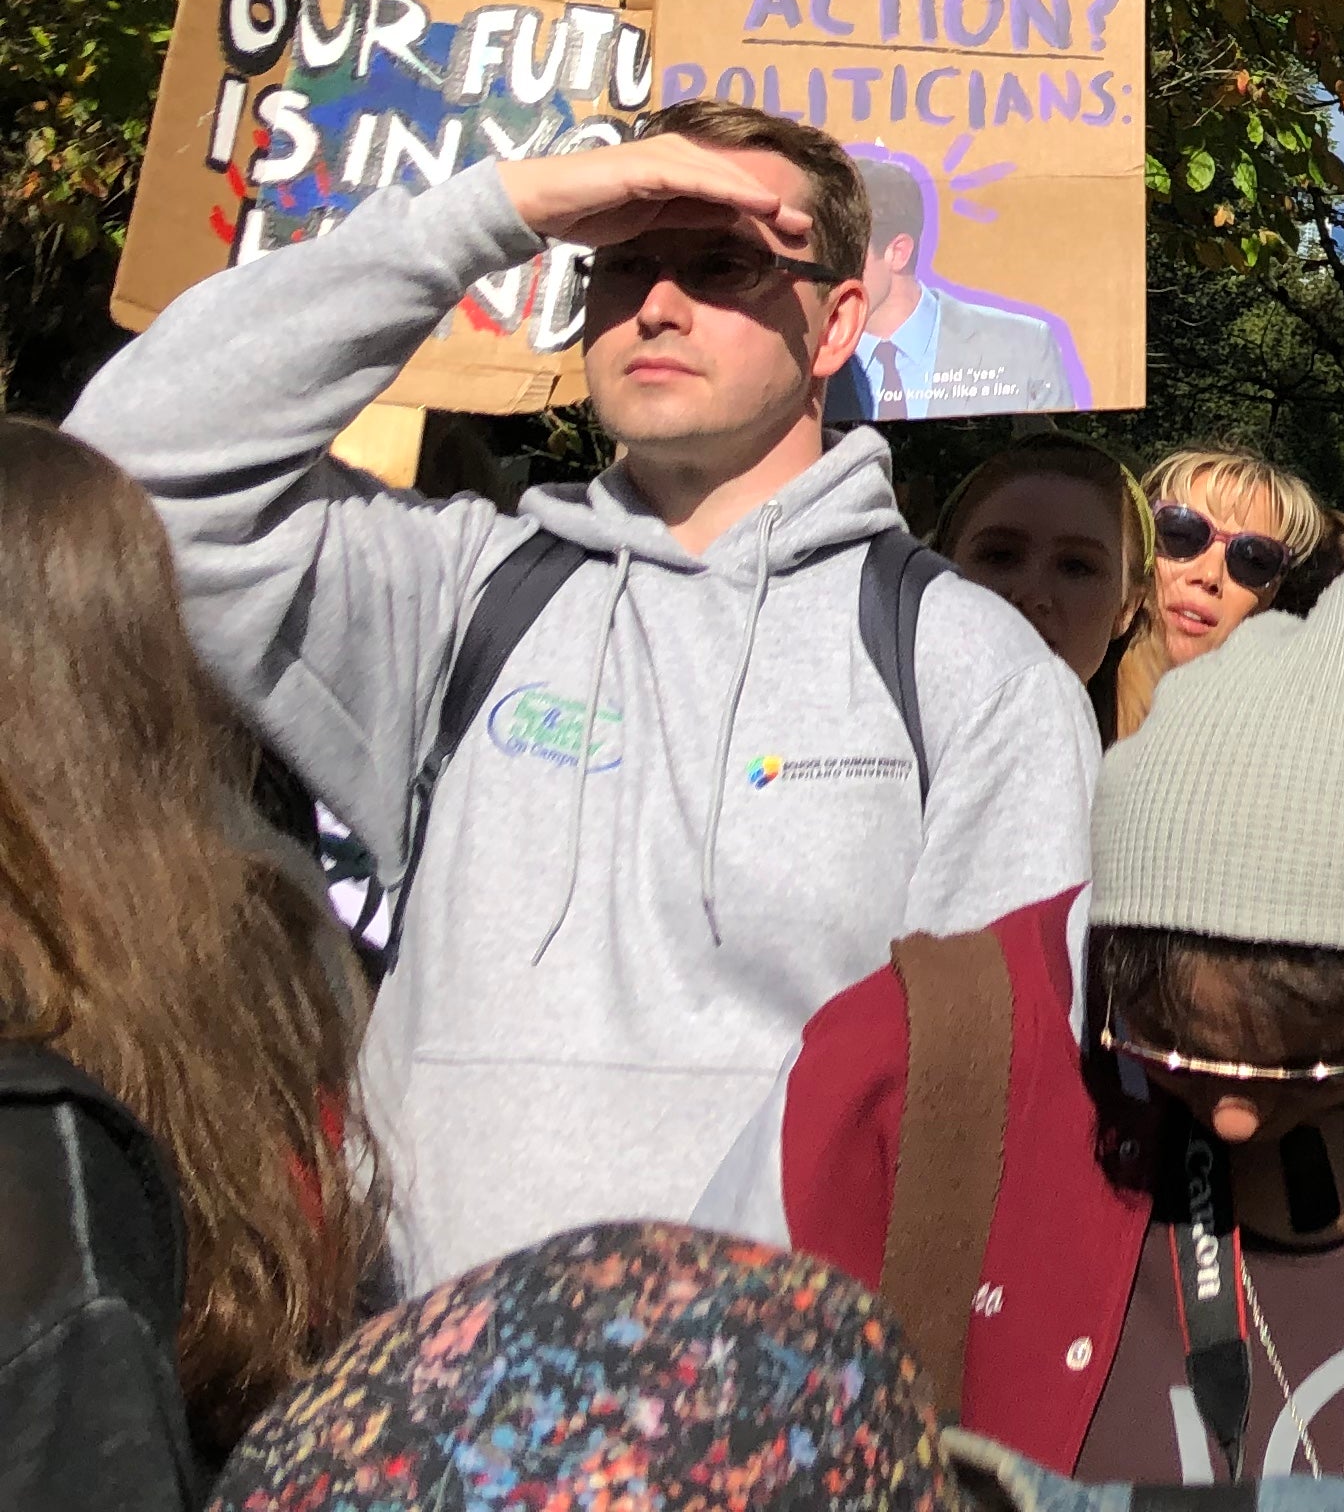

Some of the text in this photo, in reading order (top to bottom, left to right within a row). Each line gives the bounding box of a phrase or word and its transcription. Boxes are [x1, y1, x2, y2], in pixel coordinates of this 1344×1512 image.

[661, 64, 1132, 131] POLITICIANS:
[207, 75, 321, 184] IS
[341, 111, 463, 187] IN
[875, 388, 902, 402] You
[953, 383, 977, 399] like
[981, 386, 989, 397] a
[933, 368, 963, 383] said
